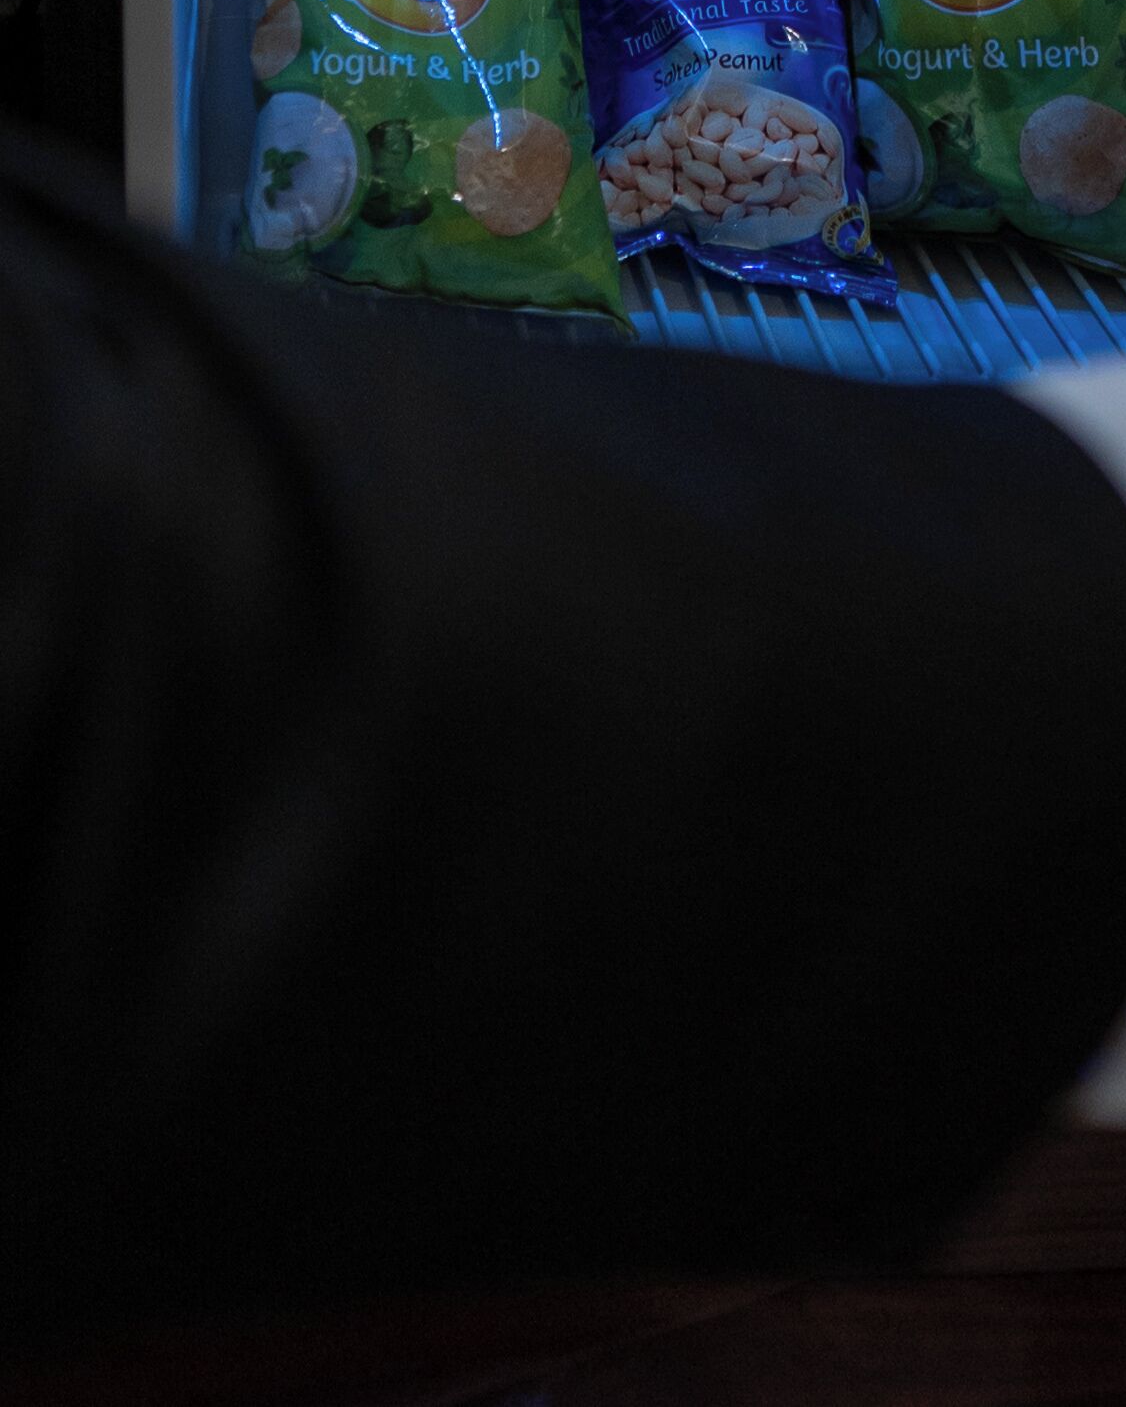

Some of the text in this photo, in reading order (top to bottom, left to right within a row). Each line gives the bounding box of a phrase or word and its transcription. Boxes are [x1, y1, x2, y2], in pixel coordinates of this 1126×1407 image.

[624, 0, 729, 58] Traditional
[309, 46, 541, 85] Yogurt & Herb
[653, 48, 785, 92] Salted Peanut
[983, 39, 1009, 69] &
[1018, 36, 1099, 68] Herb
